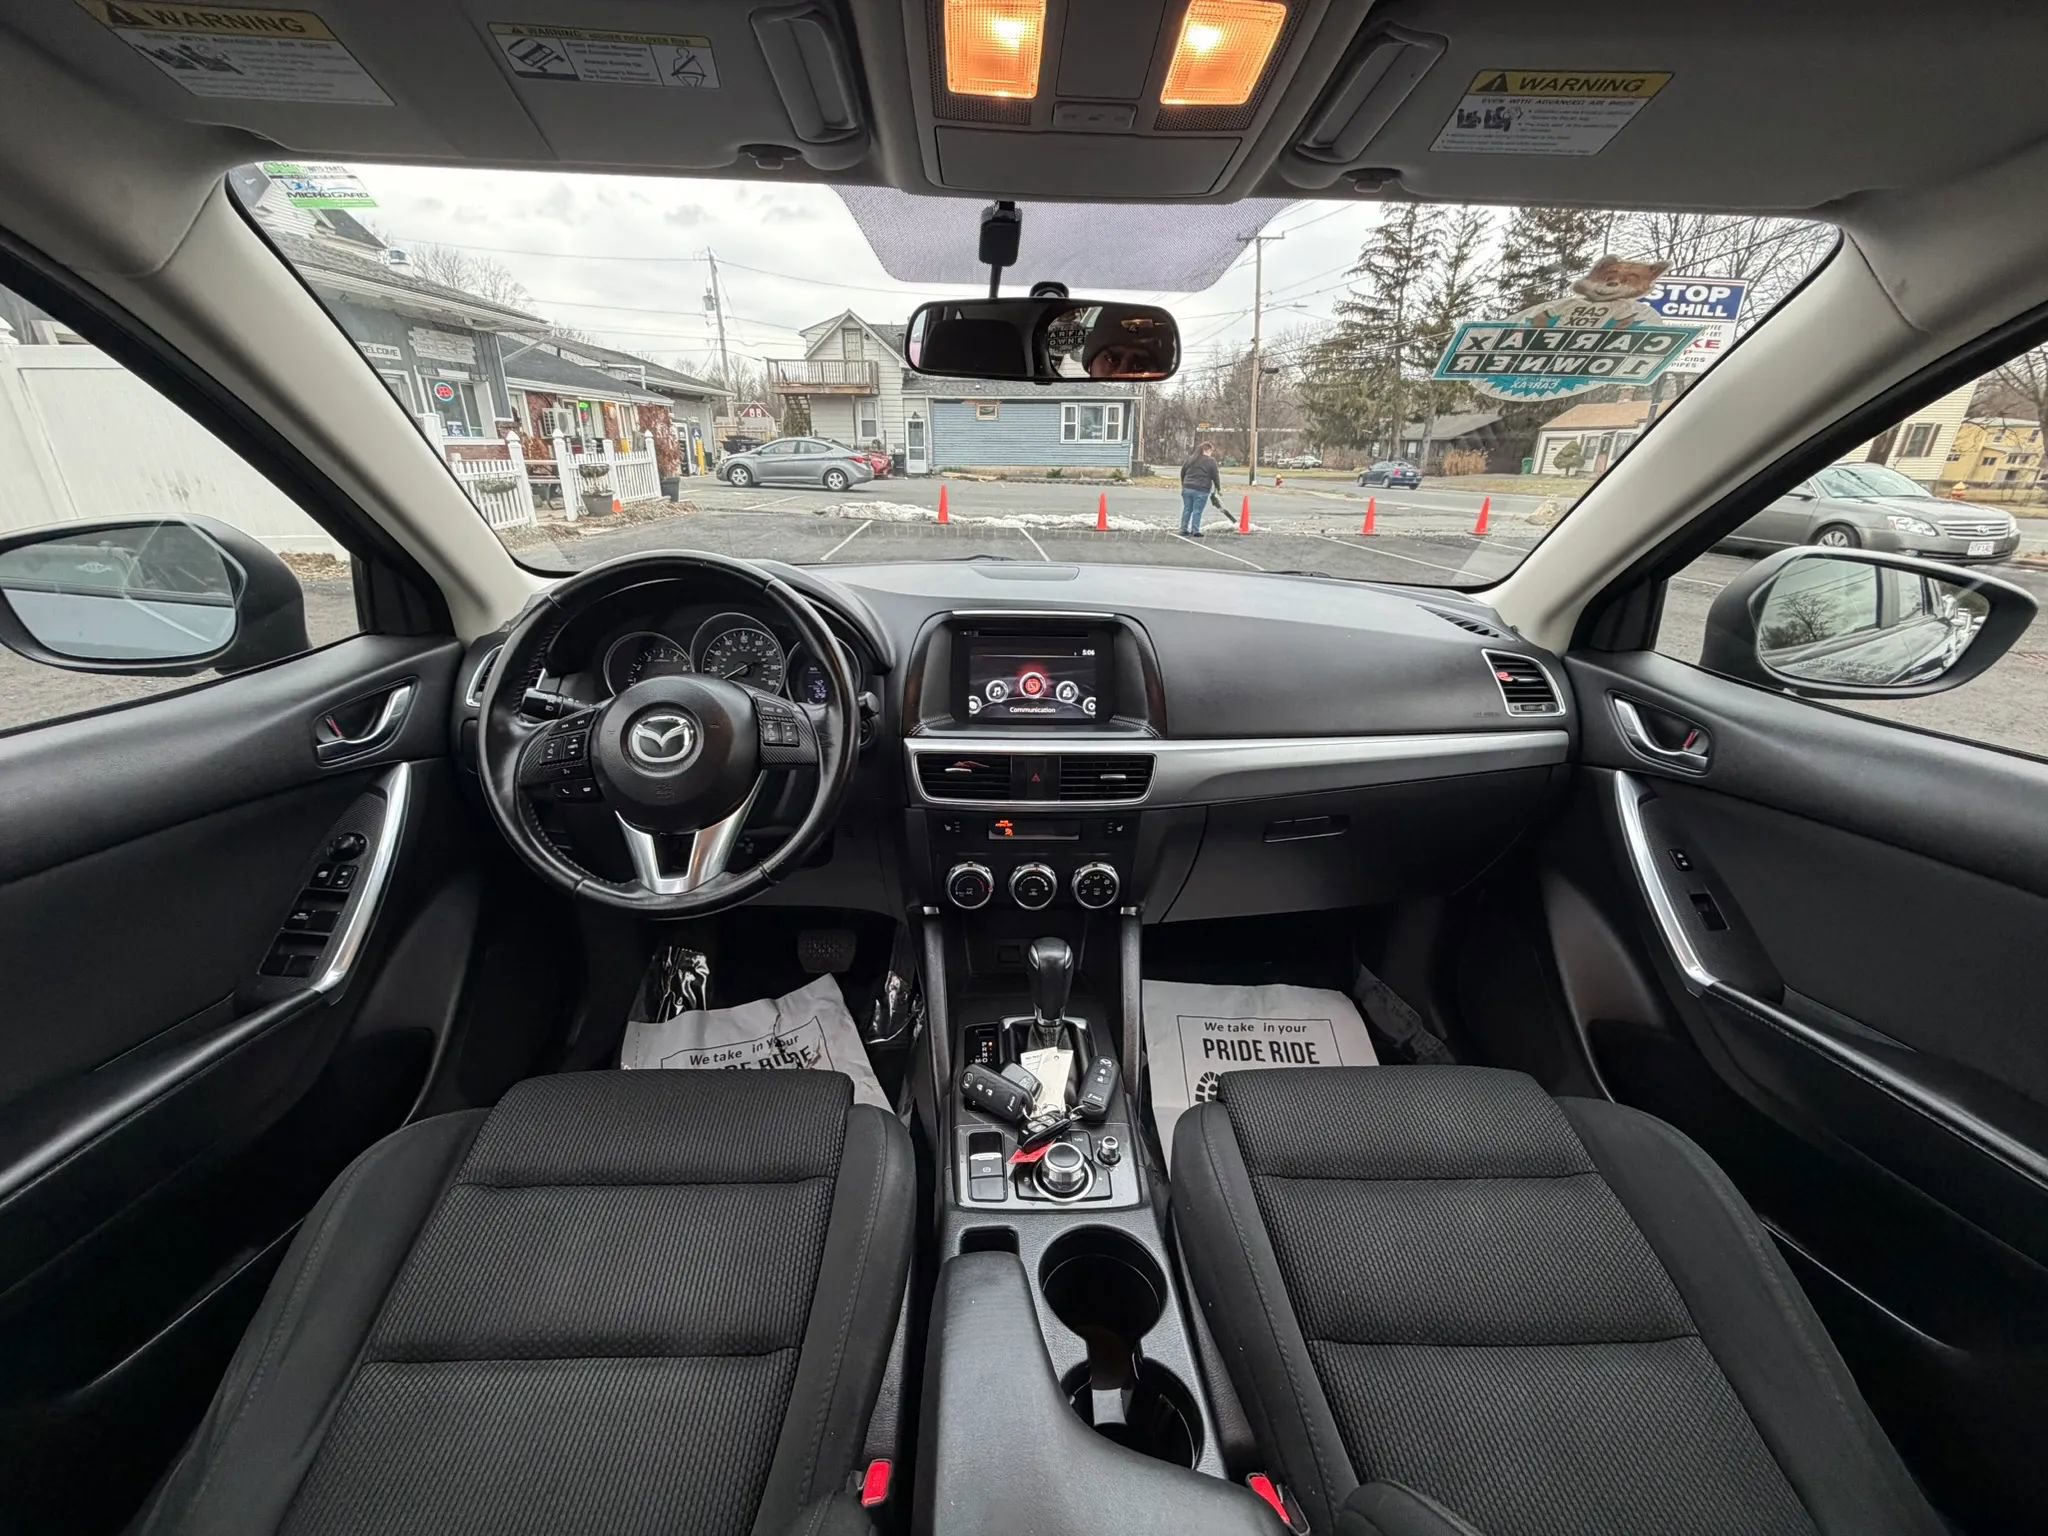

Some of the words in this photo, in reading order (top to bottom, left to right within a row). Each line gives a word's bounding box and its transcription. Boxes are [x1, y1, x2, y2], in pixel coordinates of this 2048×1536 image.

[144, 8, 306, 33] WARNING
[1519, 77, 1646, 93] WARNING
[1662, 302, 1728, 317] CHILL
[1049, 337, 1086, 346] OWNE
[1009, 706, 1056, 714] Communication
[1204, 1022, 1224, 1032] We
[1227, 1023, 1255, 1033] take
[1264, 1022, 1275, 1032] in
[1278, 1024, 1308, 1035] your
[690, 1054, 710, 1066] We
[713, 1049, 743, 1064] take
[751, 1042, 764, 1054] in
[1202, 1038, 1266, 1062] PRIDE
[1269, 1041, 1320, 1065] RIDE
